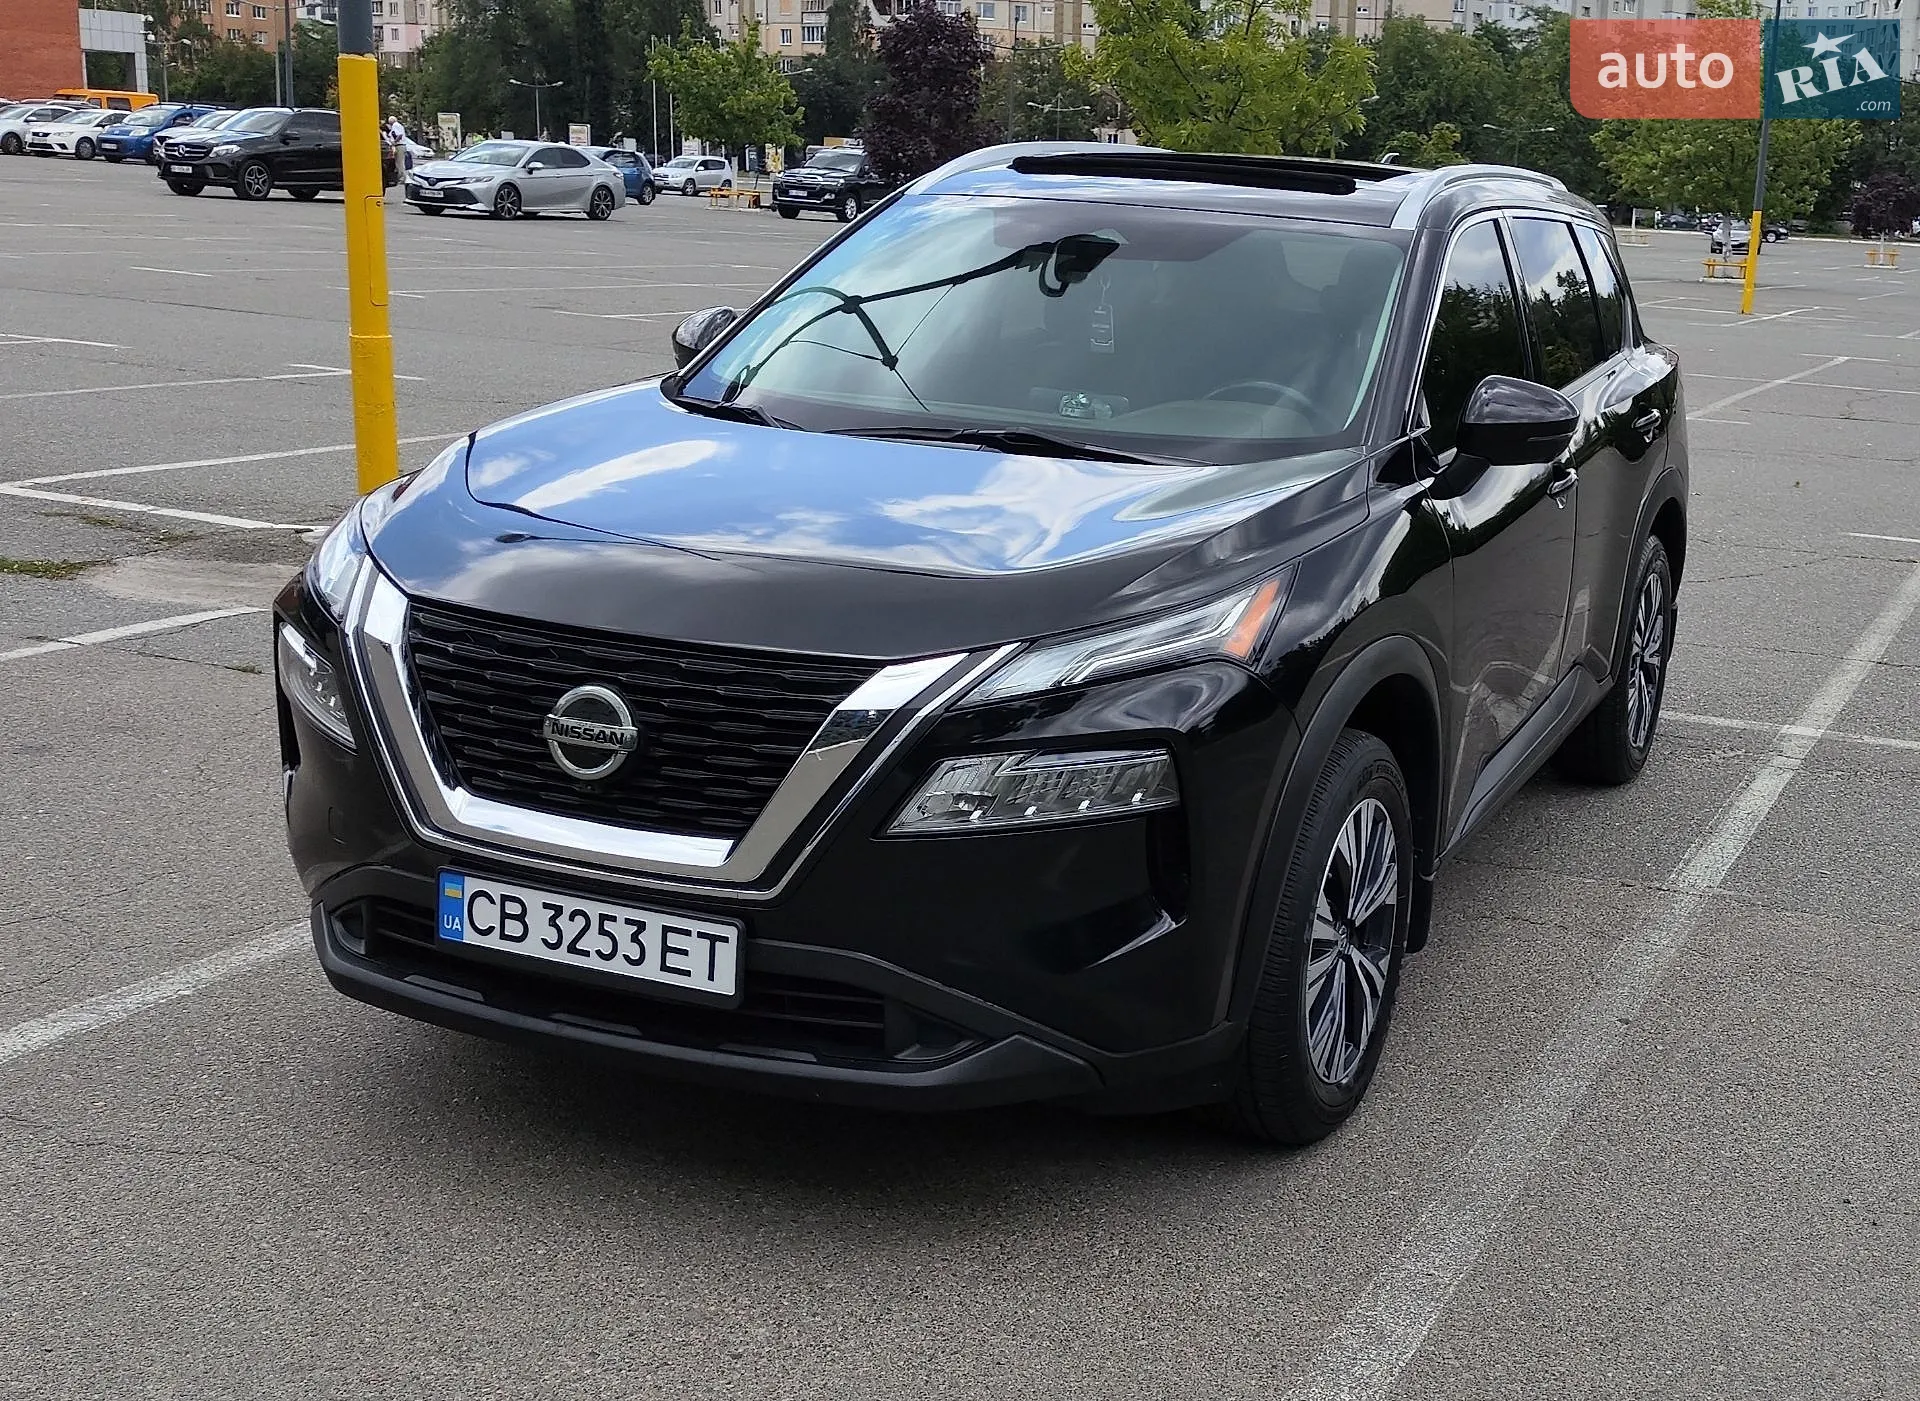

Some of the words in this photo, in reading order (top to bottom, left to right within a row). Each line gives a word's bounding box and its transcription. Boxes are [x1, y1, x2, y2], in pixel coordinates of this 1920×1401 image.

[551, 722, 625, 746] NISSAN
[444, 914, 462, 931] UA
[467, 888, 530, 944] CB
[540, 901, 647, 967] 3253
[659, 924, 730, 983] ET
